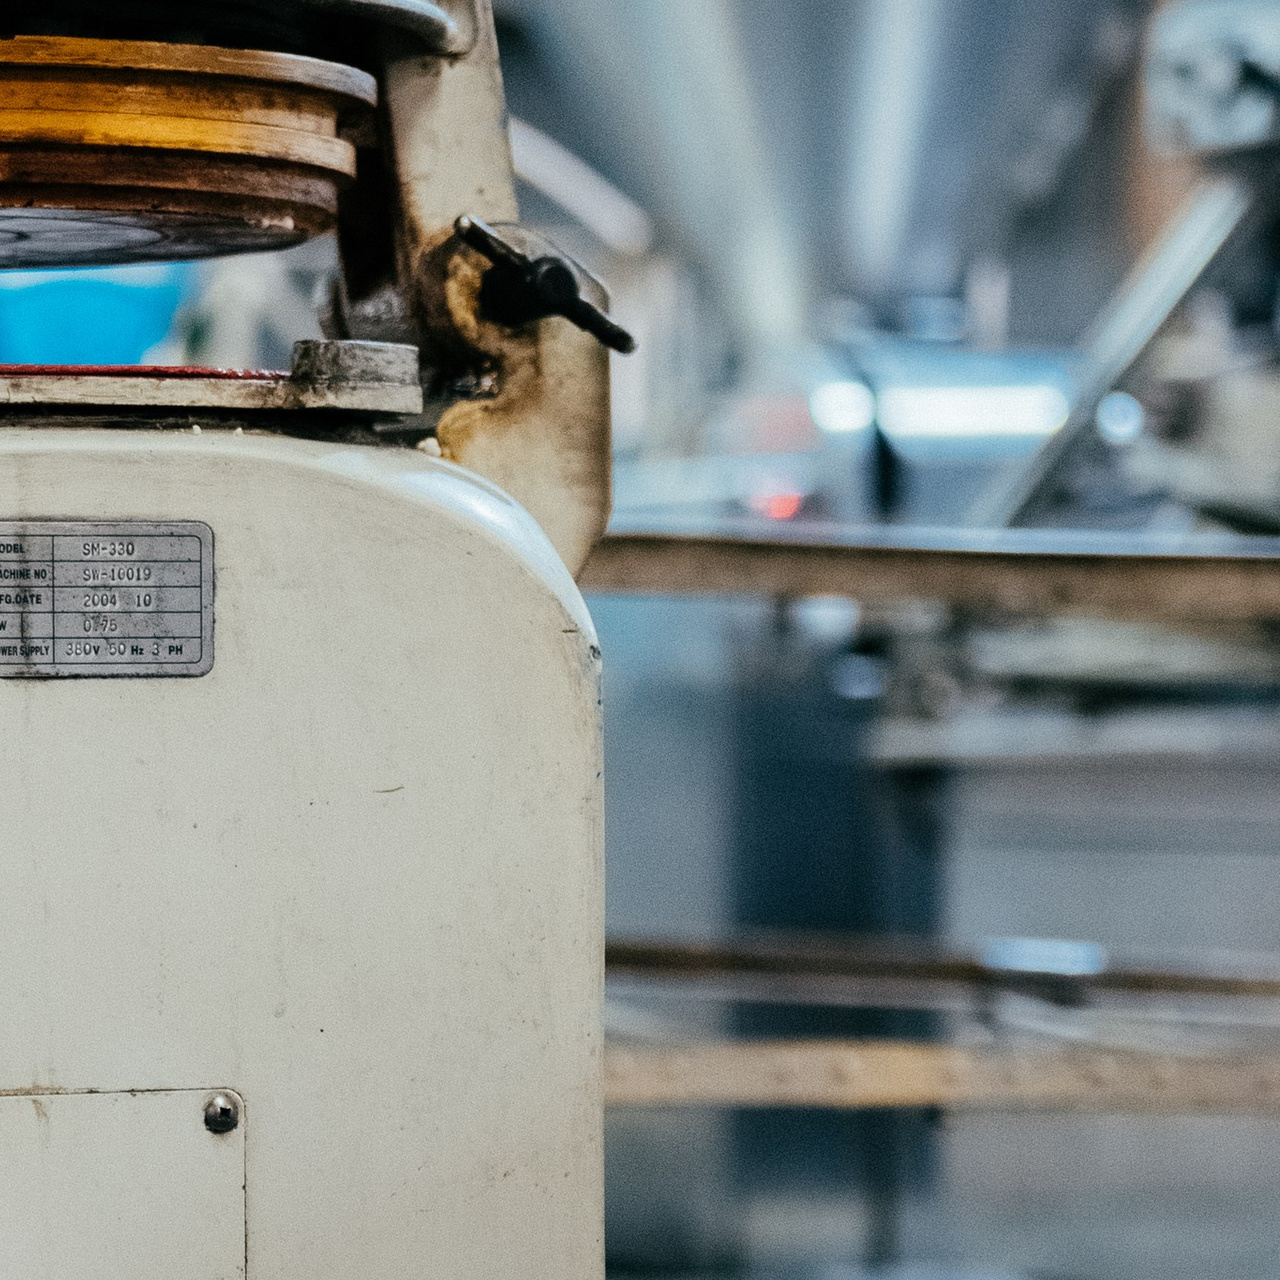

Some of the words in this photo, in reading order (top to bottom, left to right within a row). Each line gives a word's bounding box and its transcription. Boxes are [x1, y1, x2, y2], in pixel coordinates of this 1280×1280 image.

[82, 542, 135, 556] SM-330
[33, 568, 48, 580] NO
[83, 593, 117, 608] 2004
[136, 593, 152, 608] 10
[19, 645, 50, 657] SUPPLY
[131, 645, 145, 656] Hz
[168, 645, 183, 655] PH
